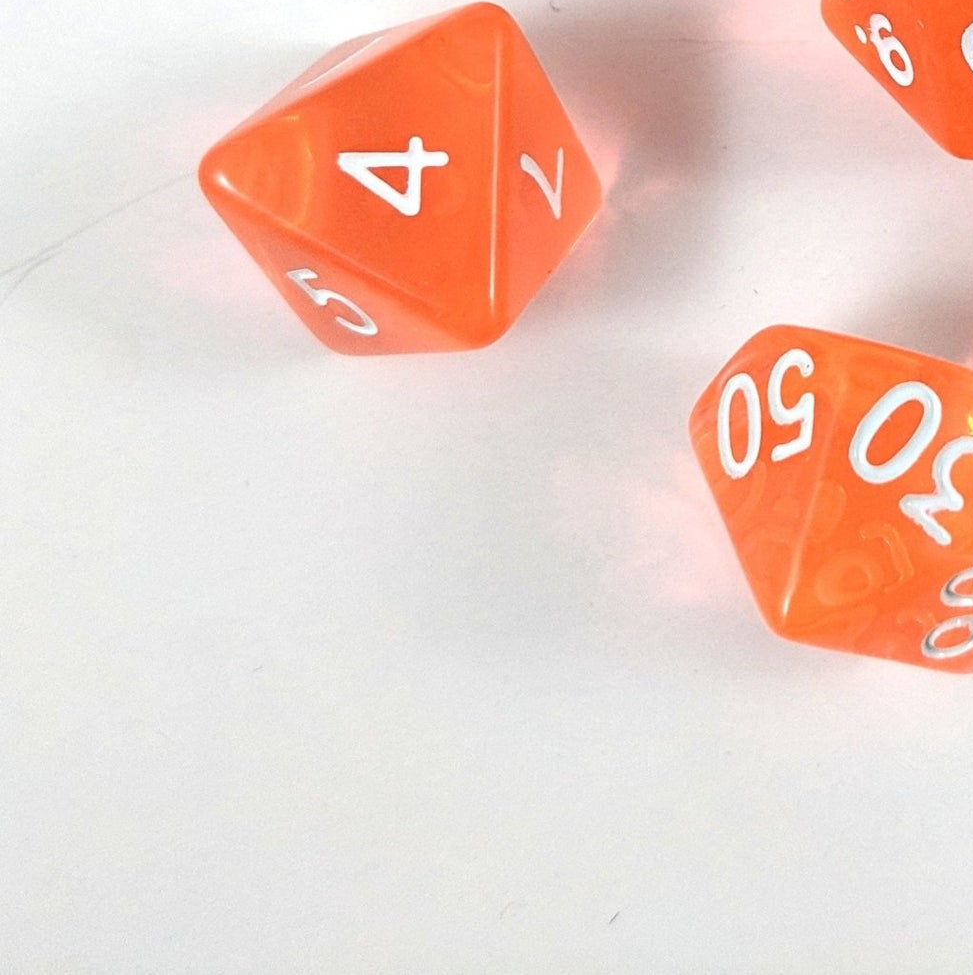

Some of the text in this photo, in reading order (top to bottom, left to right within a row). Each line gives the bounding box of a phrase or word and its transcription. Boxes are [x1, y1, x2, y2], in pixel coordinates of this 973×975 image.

[336, 136, 449, 216] 4
[286, 268, 379, 336] 5
[717, 348, 815, 479] 50
